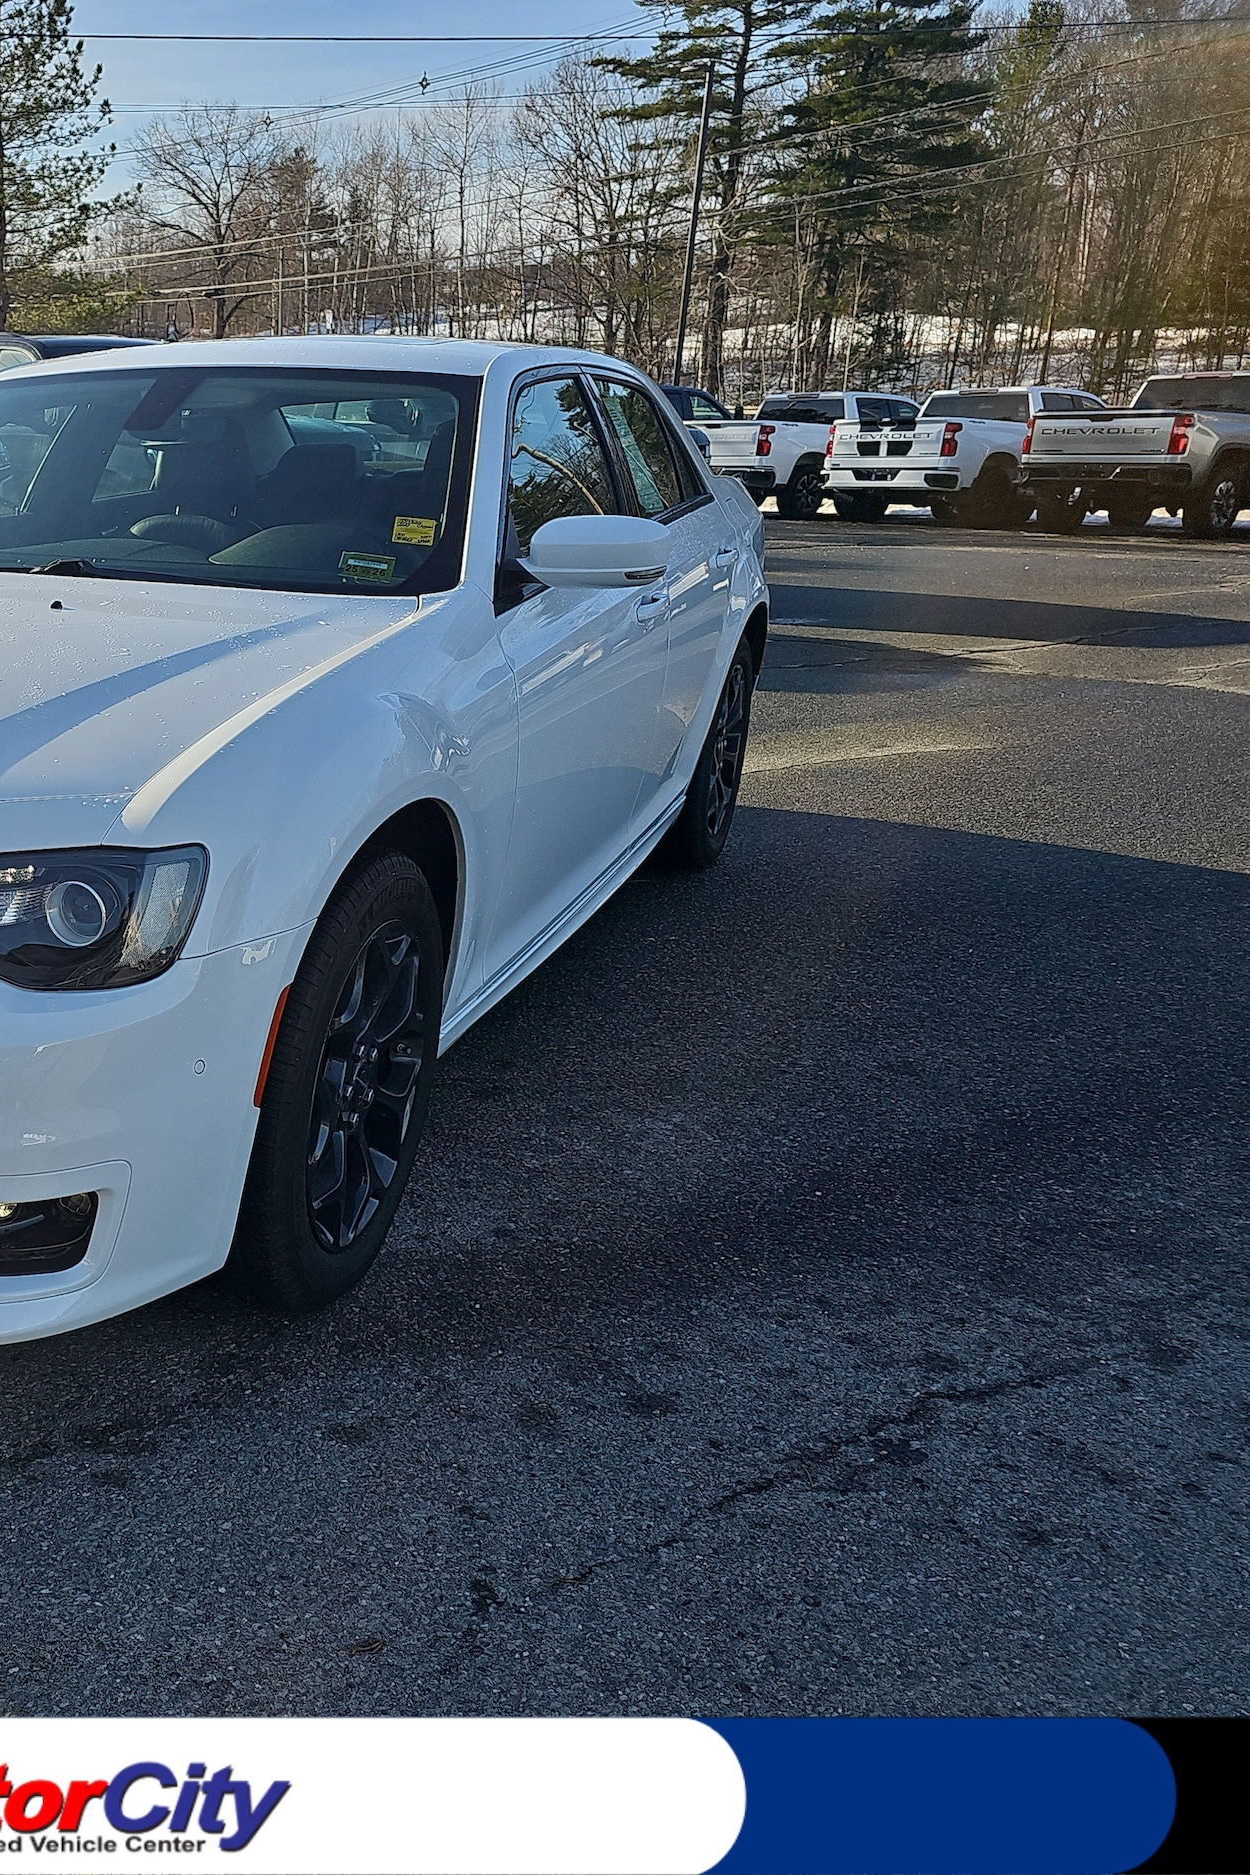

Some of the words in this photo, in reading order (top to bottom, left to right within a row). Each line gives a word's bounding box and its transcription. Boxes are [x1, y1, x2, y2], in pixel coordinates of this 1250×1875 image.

[1041, 427, 1162, 436] CHEVROLET
[839, 432, 934, 441] CHEVROLET
[345, 565, 358, 573] 25
[372, 569, 386, 577] 26
